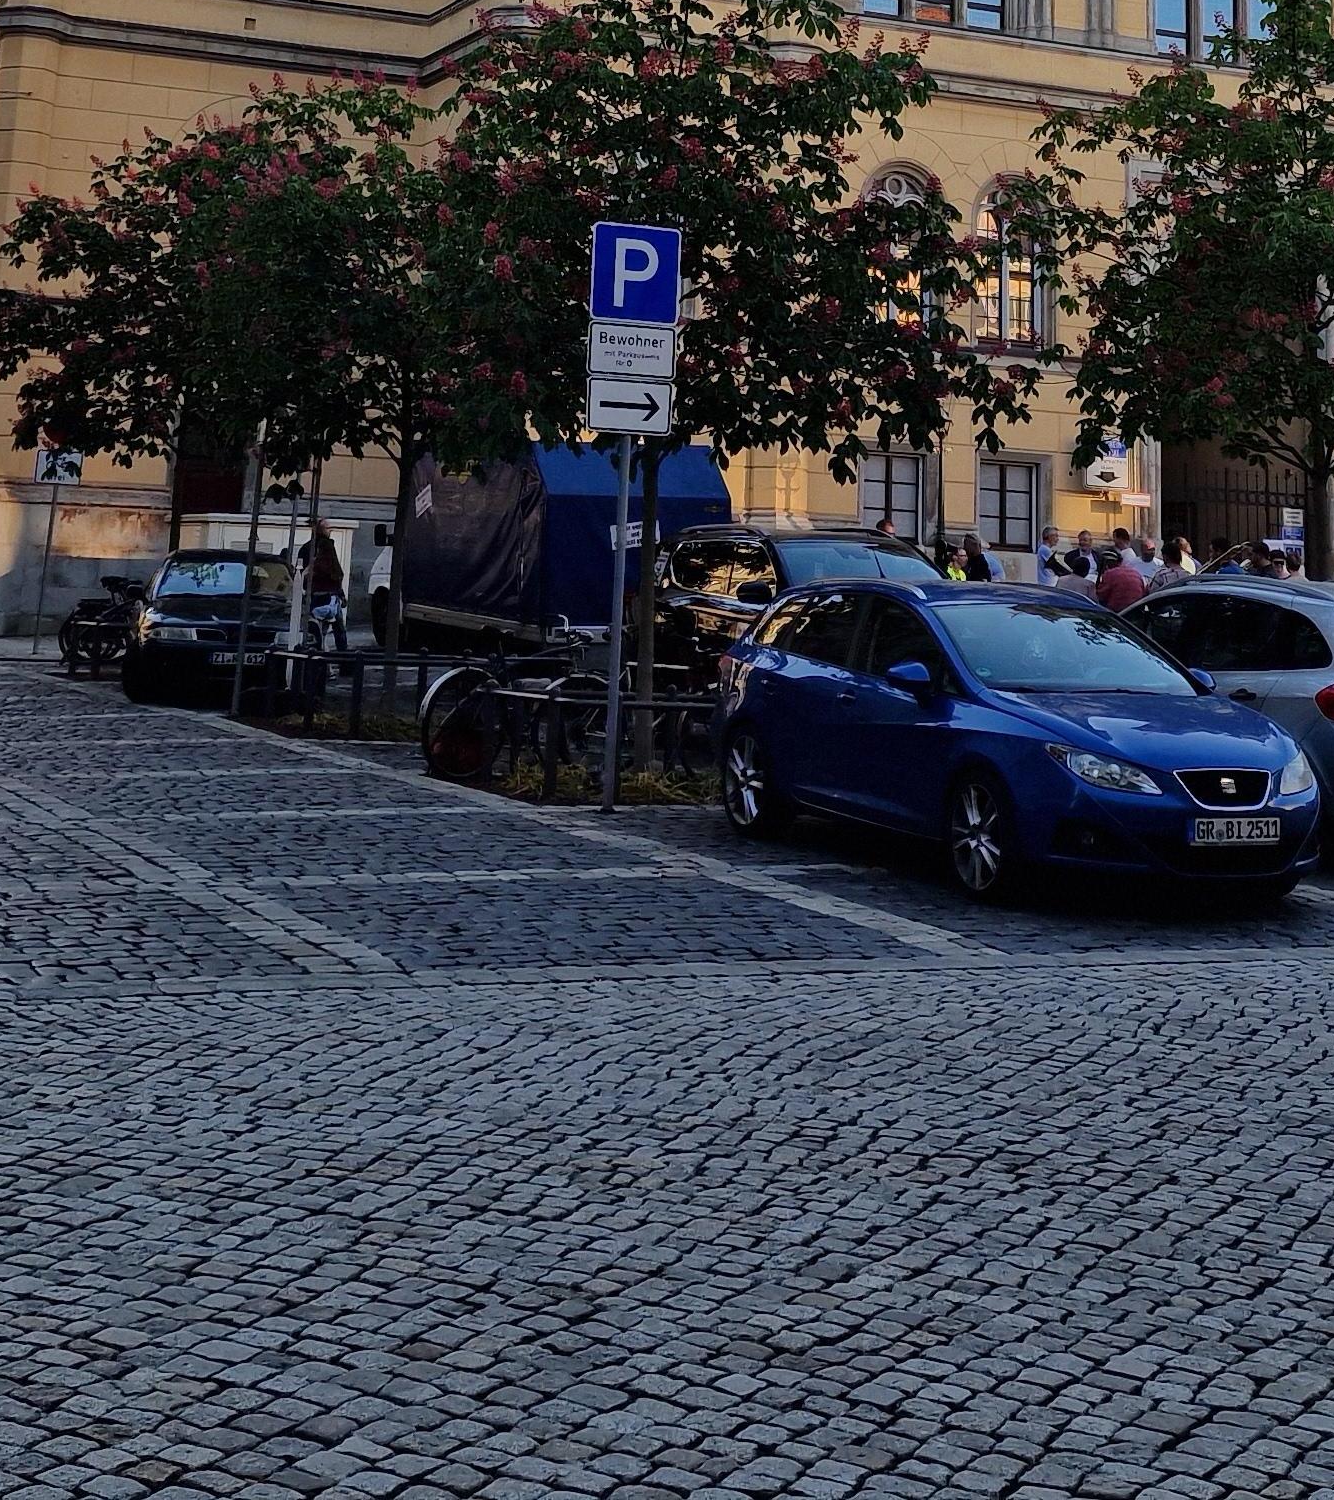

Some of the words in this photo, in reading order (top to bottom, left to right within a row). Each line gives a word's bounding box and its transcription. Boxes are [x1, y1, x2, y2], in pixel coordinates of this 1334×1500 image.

[613, 237, 659, 307] P
[599, 331, 666, 348] Bewohner
[617, 350, 660, 360] Parkauss
[1196, 820, 1215, 840] GR
[1226, 820, 1244, 839] BI
[1246, 819, 1279, 839] 2511
